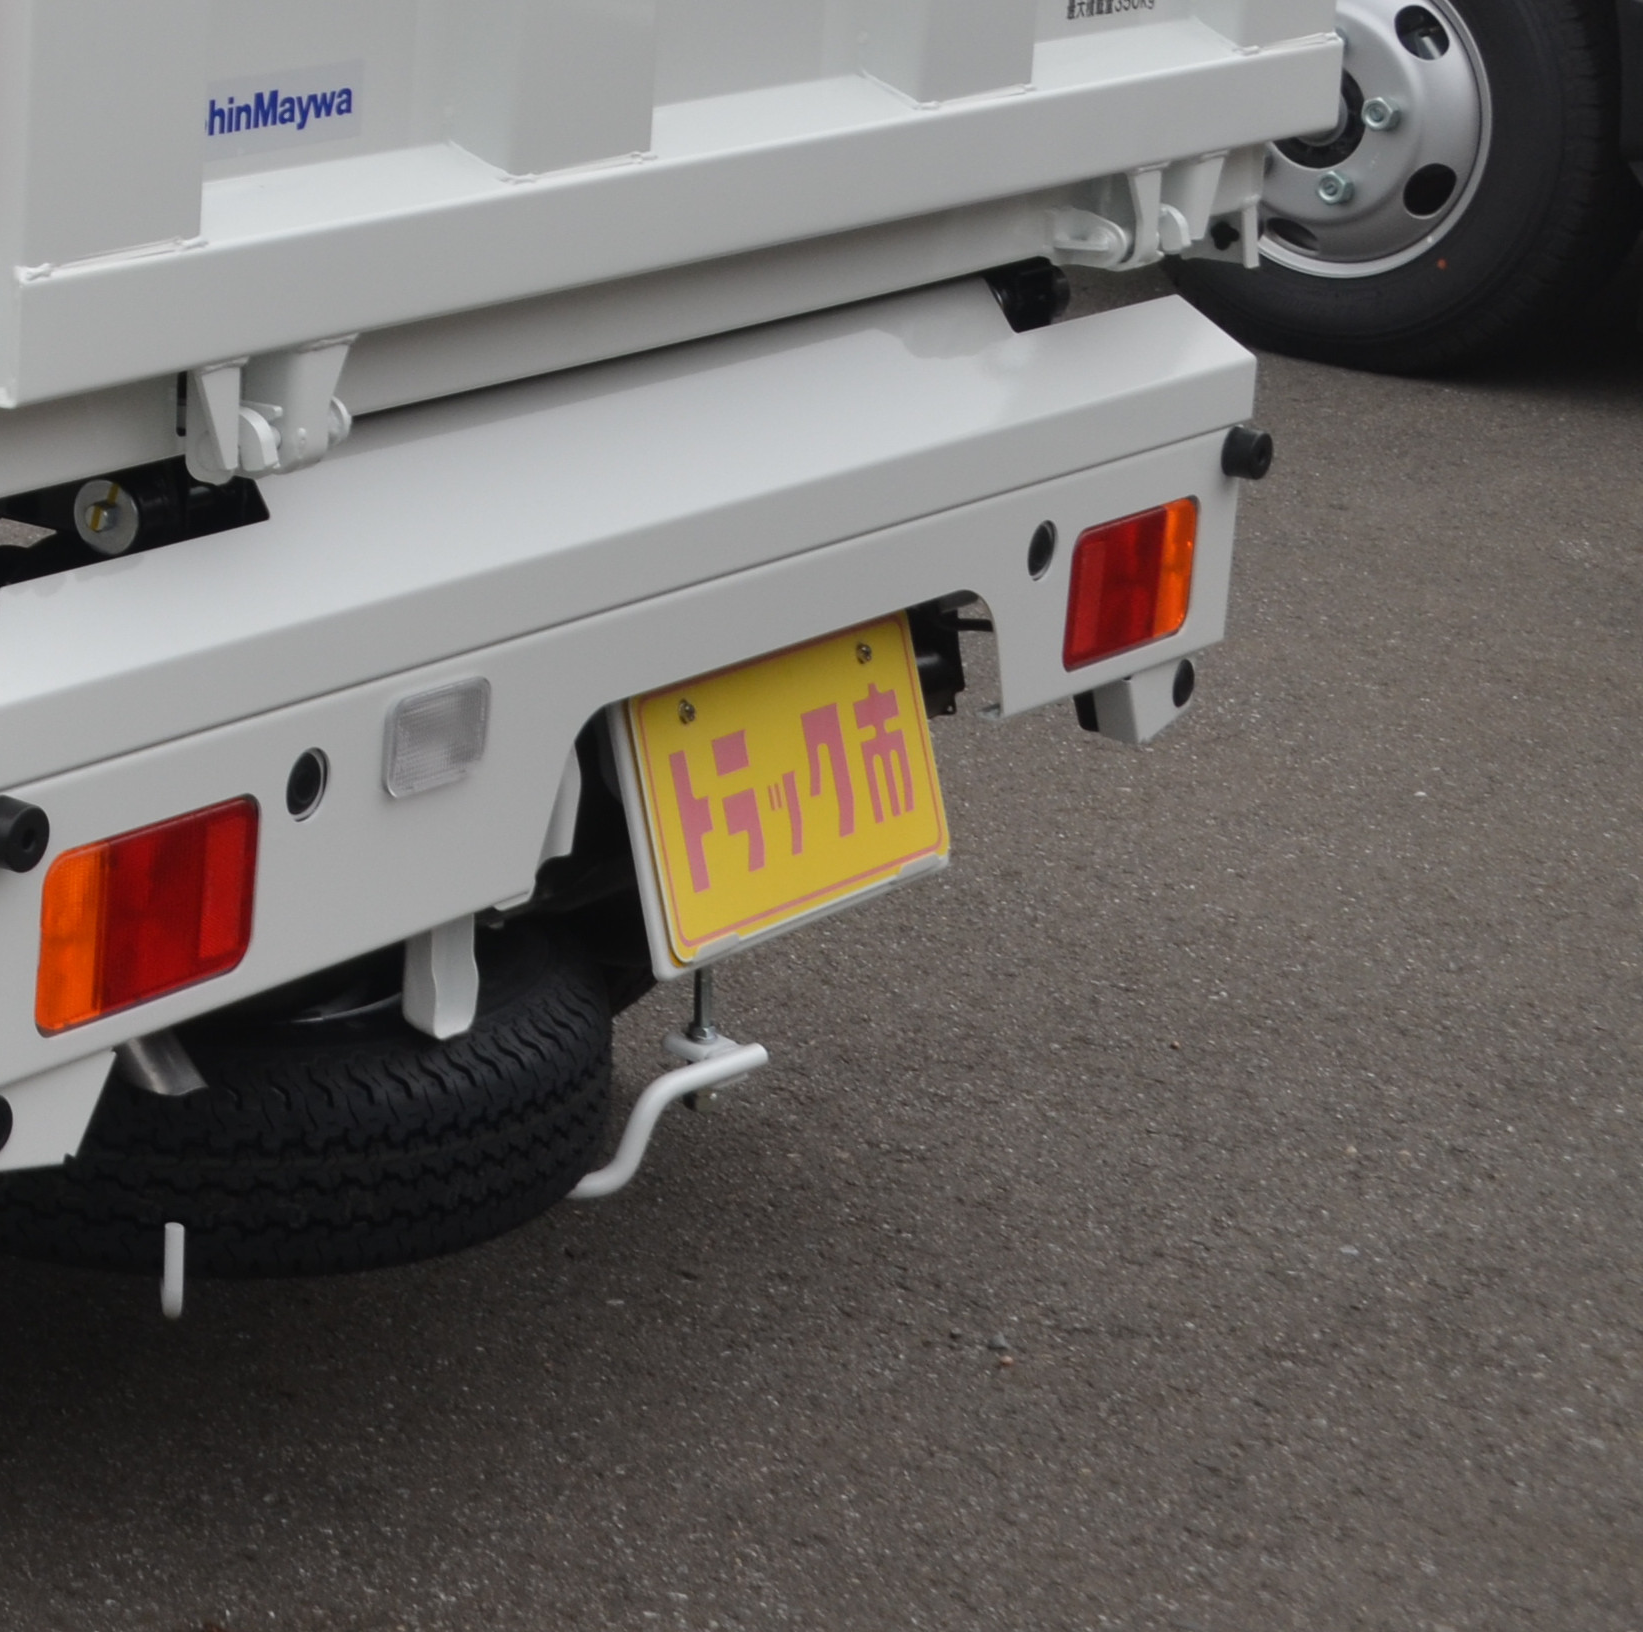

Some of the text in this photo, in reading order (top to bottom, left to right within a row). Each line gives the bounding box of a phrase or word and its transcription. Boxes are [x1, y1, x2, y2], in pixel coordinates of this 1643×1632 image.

[205, 88, 353, 136] hinMaywa
[668, 682, 915, 894] トラック市
